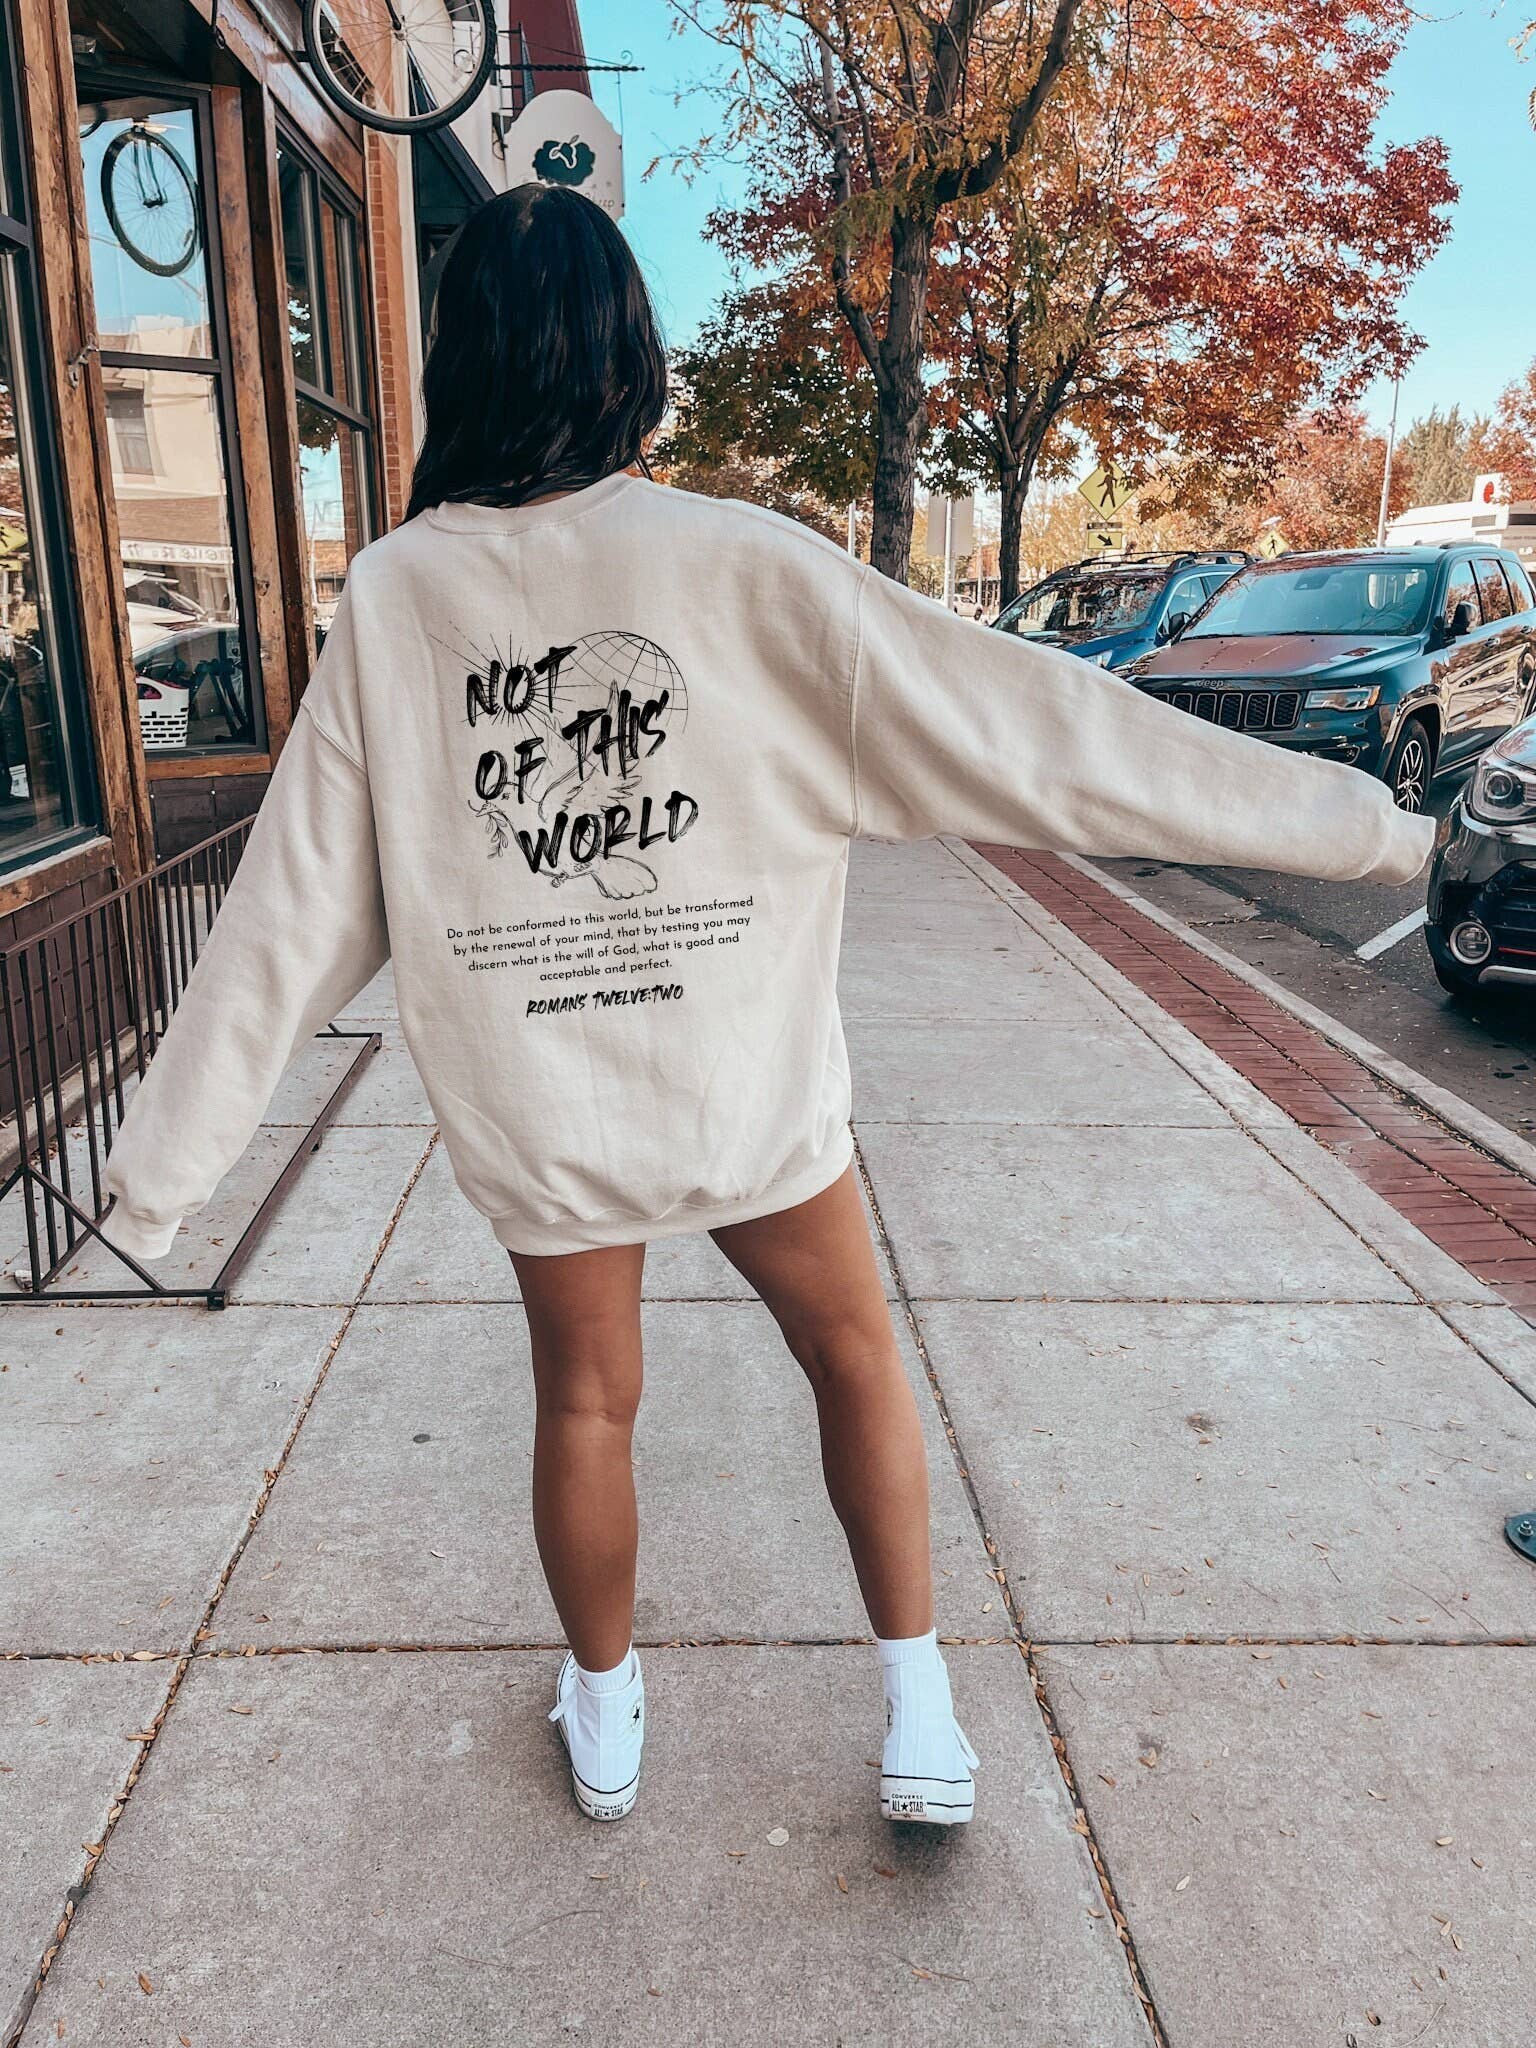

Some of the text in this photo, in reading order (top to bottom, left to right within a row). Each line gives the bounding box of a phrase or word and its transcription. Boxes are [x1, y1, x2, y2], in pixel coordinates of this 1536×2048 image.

[466, 646, 577, 728] NOT
[1196, 679, 1224, 690] Jeep
[475, 689, 669, 804] OF THIS
[519, 790, 699, 873] WORLD
[447, 895, 754, 939] Do not be conformed to this world, but be transformed
[453, 916, 751, 957] by the renewal of your mind, that by testing you may
[468, 931, 740, 971] discern what is the will of God, what is good and
[539, 958, 672, 981] acceptable and perfect.
[526, 993, 588, 1018] ROMANS
